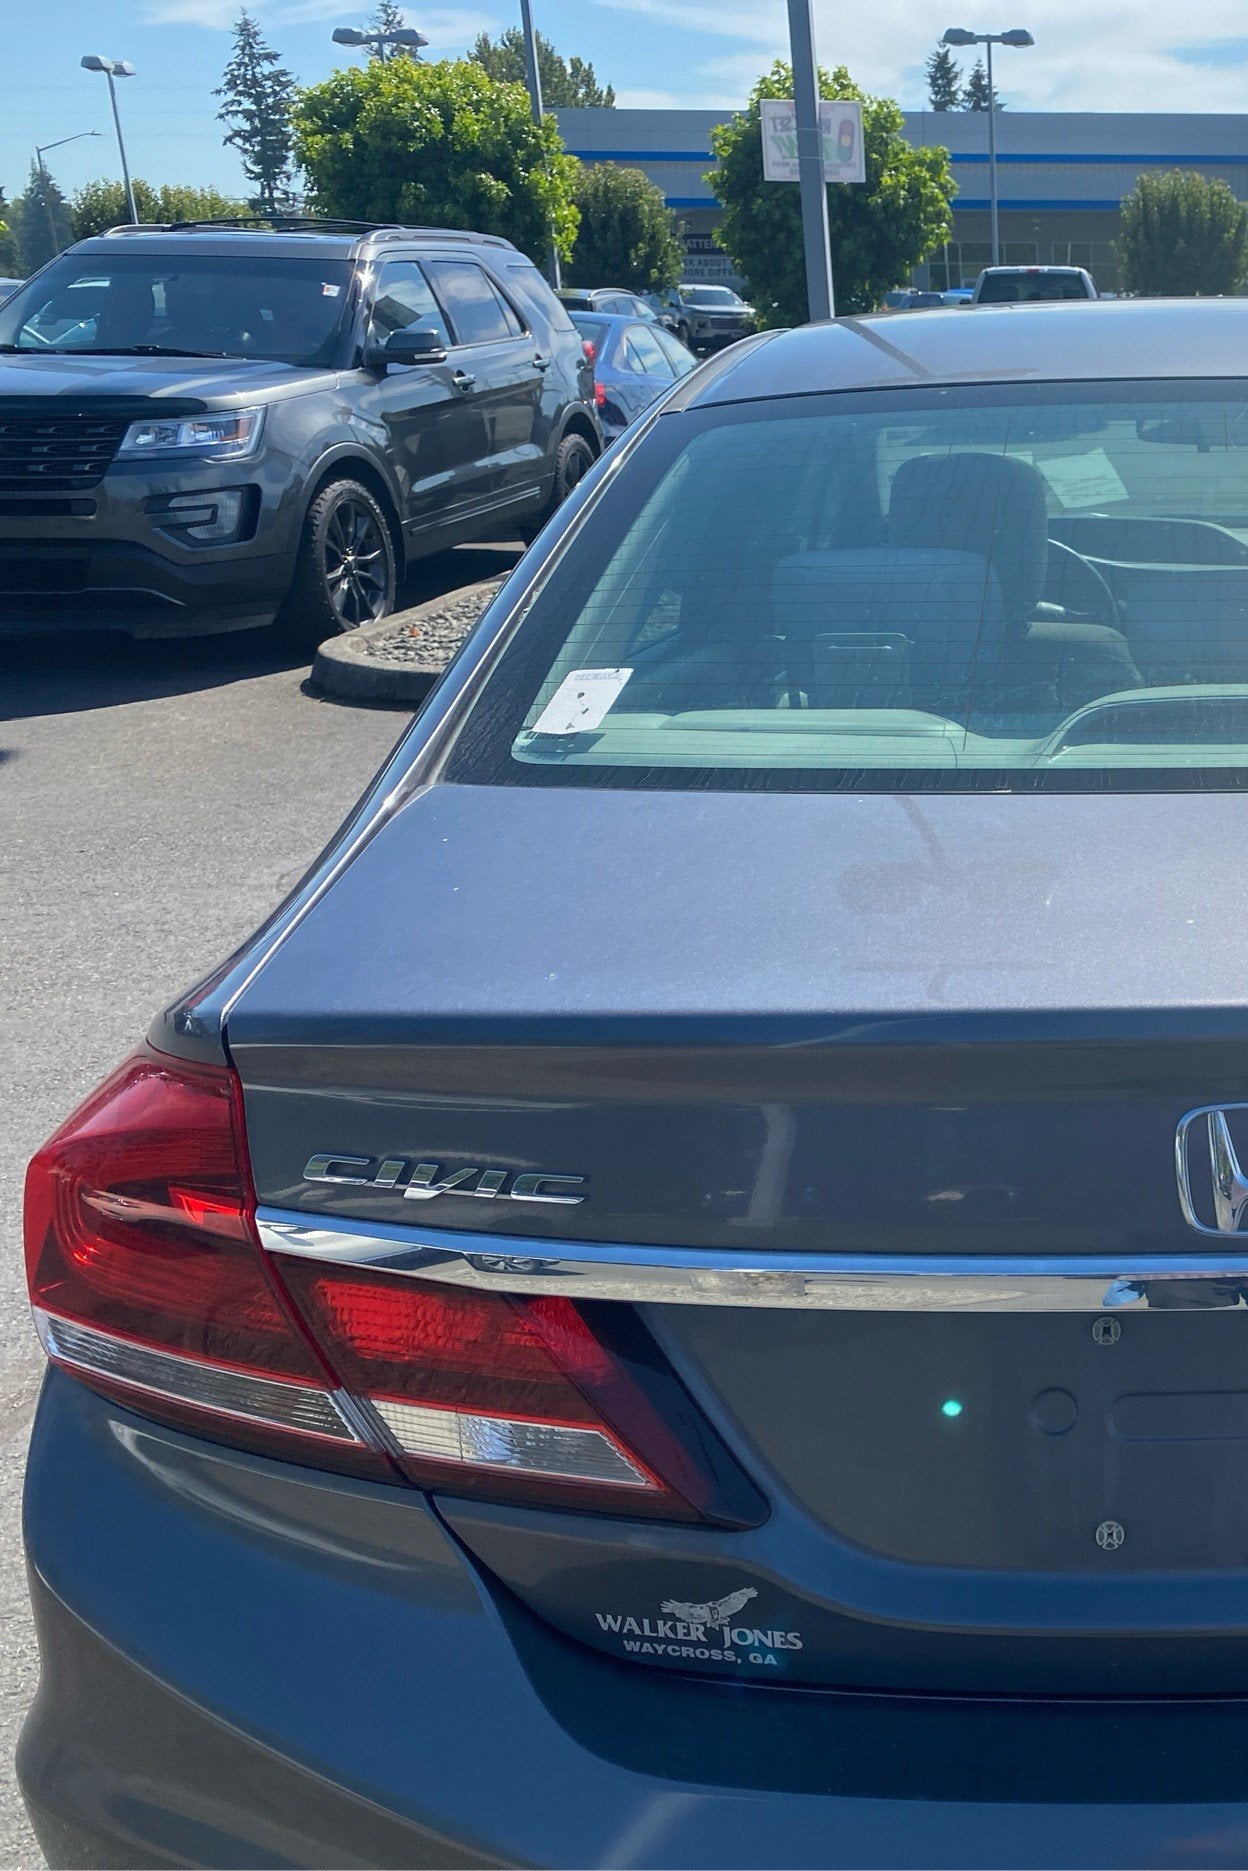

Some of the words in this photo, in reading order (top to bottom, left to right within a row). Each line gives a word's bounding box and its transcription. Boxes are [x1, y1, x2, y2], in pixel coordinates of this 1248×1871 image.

[697, 258, 727, 267] ABOUT
[708, 268, 735, 277] DIFFE
[302, 1153, 585, 1205] CIVIC
[594, 1612, 708, 1642] WALKER
[721, 1626, 804, 1651] JONES
[622, 1639, 743, 1664] WAYCROSS,
[747, 1652, 779, 1666] GA
